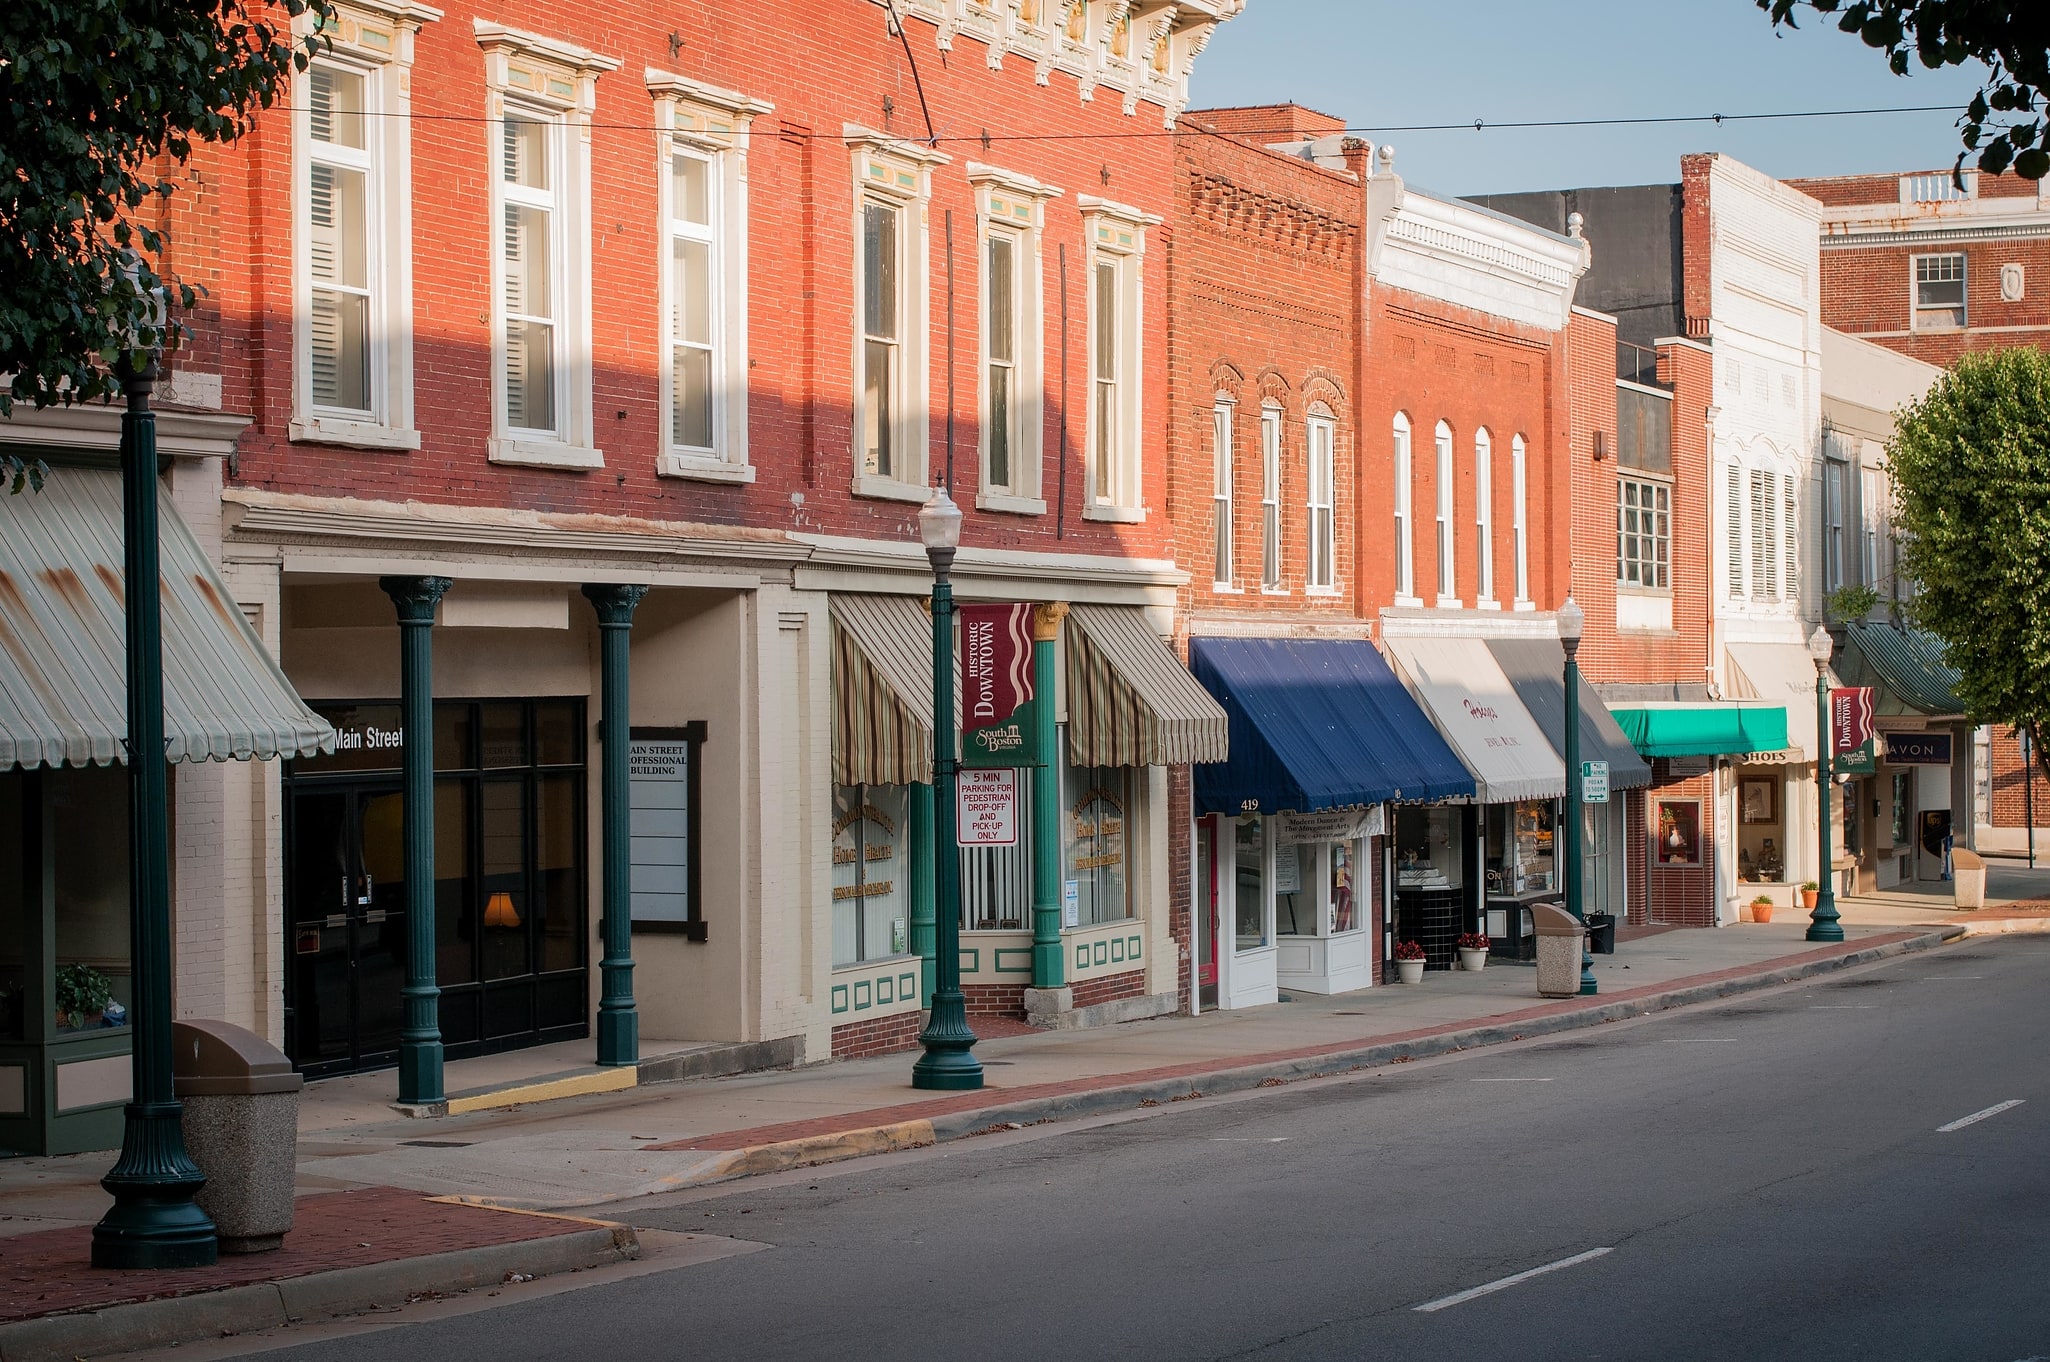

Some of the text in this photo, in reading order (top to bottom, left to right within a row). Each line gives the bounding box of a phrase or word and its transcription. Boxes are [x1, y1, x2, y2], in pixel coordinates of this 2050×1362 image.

[969, 622, 979, 678] HISTORIC
[974, 620, 994, 718] DOWNTOWN
[333, 727, 403, 749] Main Street
[975, 727, 1007, 747] South
[988, 737, 1023, 752] Boston
[630, 746, 684, 755] AIN STREET
[1888, 744, 1934, 755] AVON
[630, 756, 687, 765] OFESSIONAL
[1741, 752, 1786, 761] SHOES
[630, 766, 676, 775] BUILDING
[973, 772, 1001, 782] 5 MIN
[961, 784, 1012, 793] PARKING FOR
[963, 793, 1011, 802] PEDESTRIAN
[967, 803, 1006, 811] DROP-OFF
[1241, 799, 1258, 811] 419
[979, 813, 996, 821] AND
[972, 822, 1003, 830] PICK-UP
[1284, 825, 1298, 833] The
[977, 831, 998, 839] ONLY
